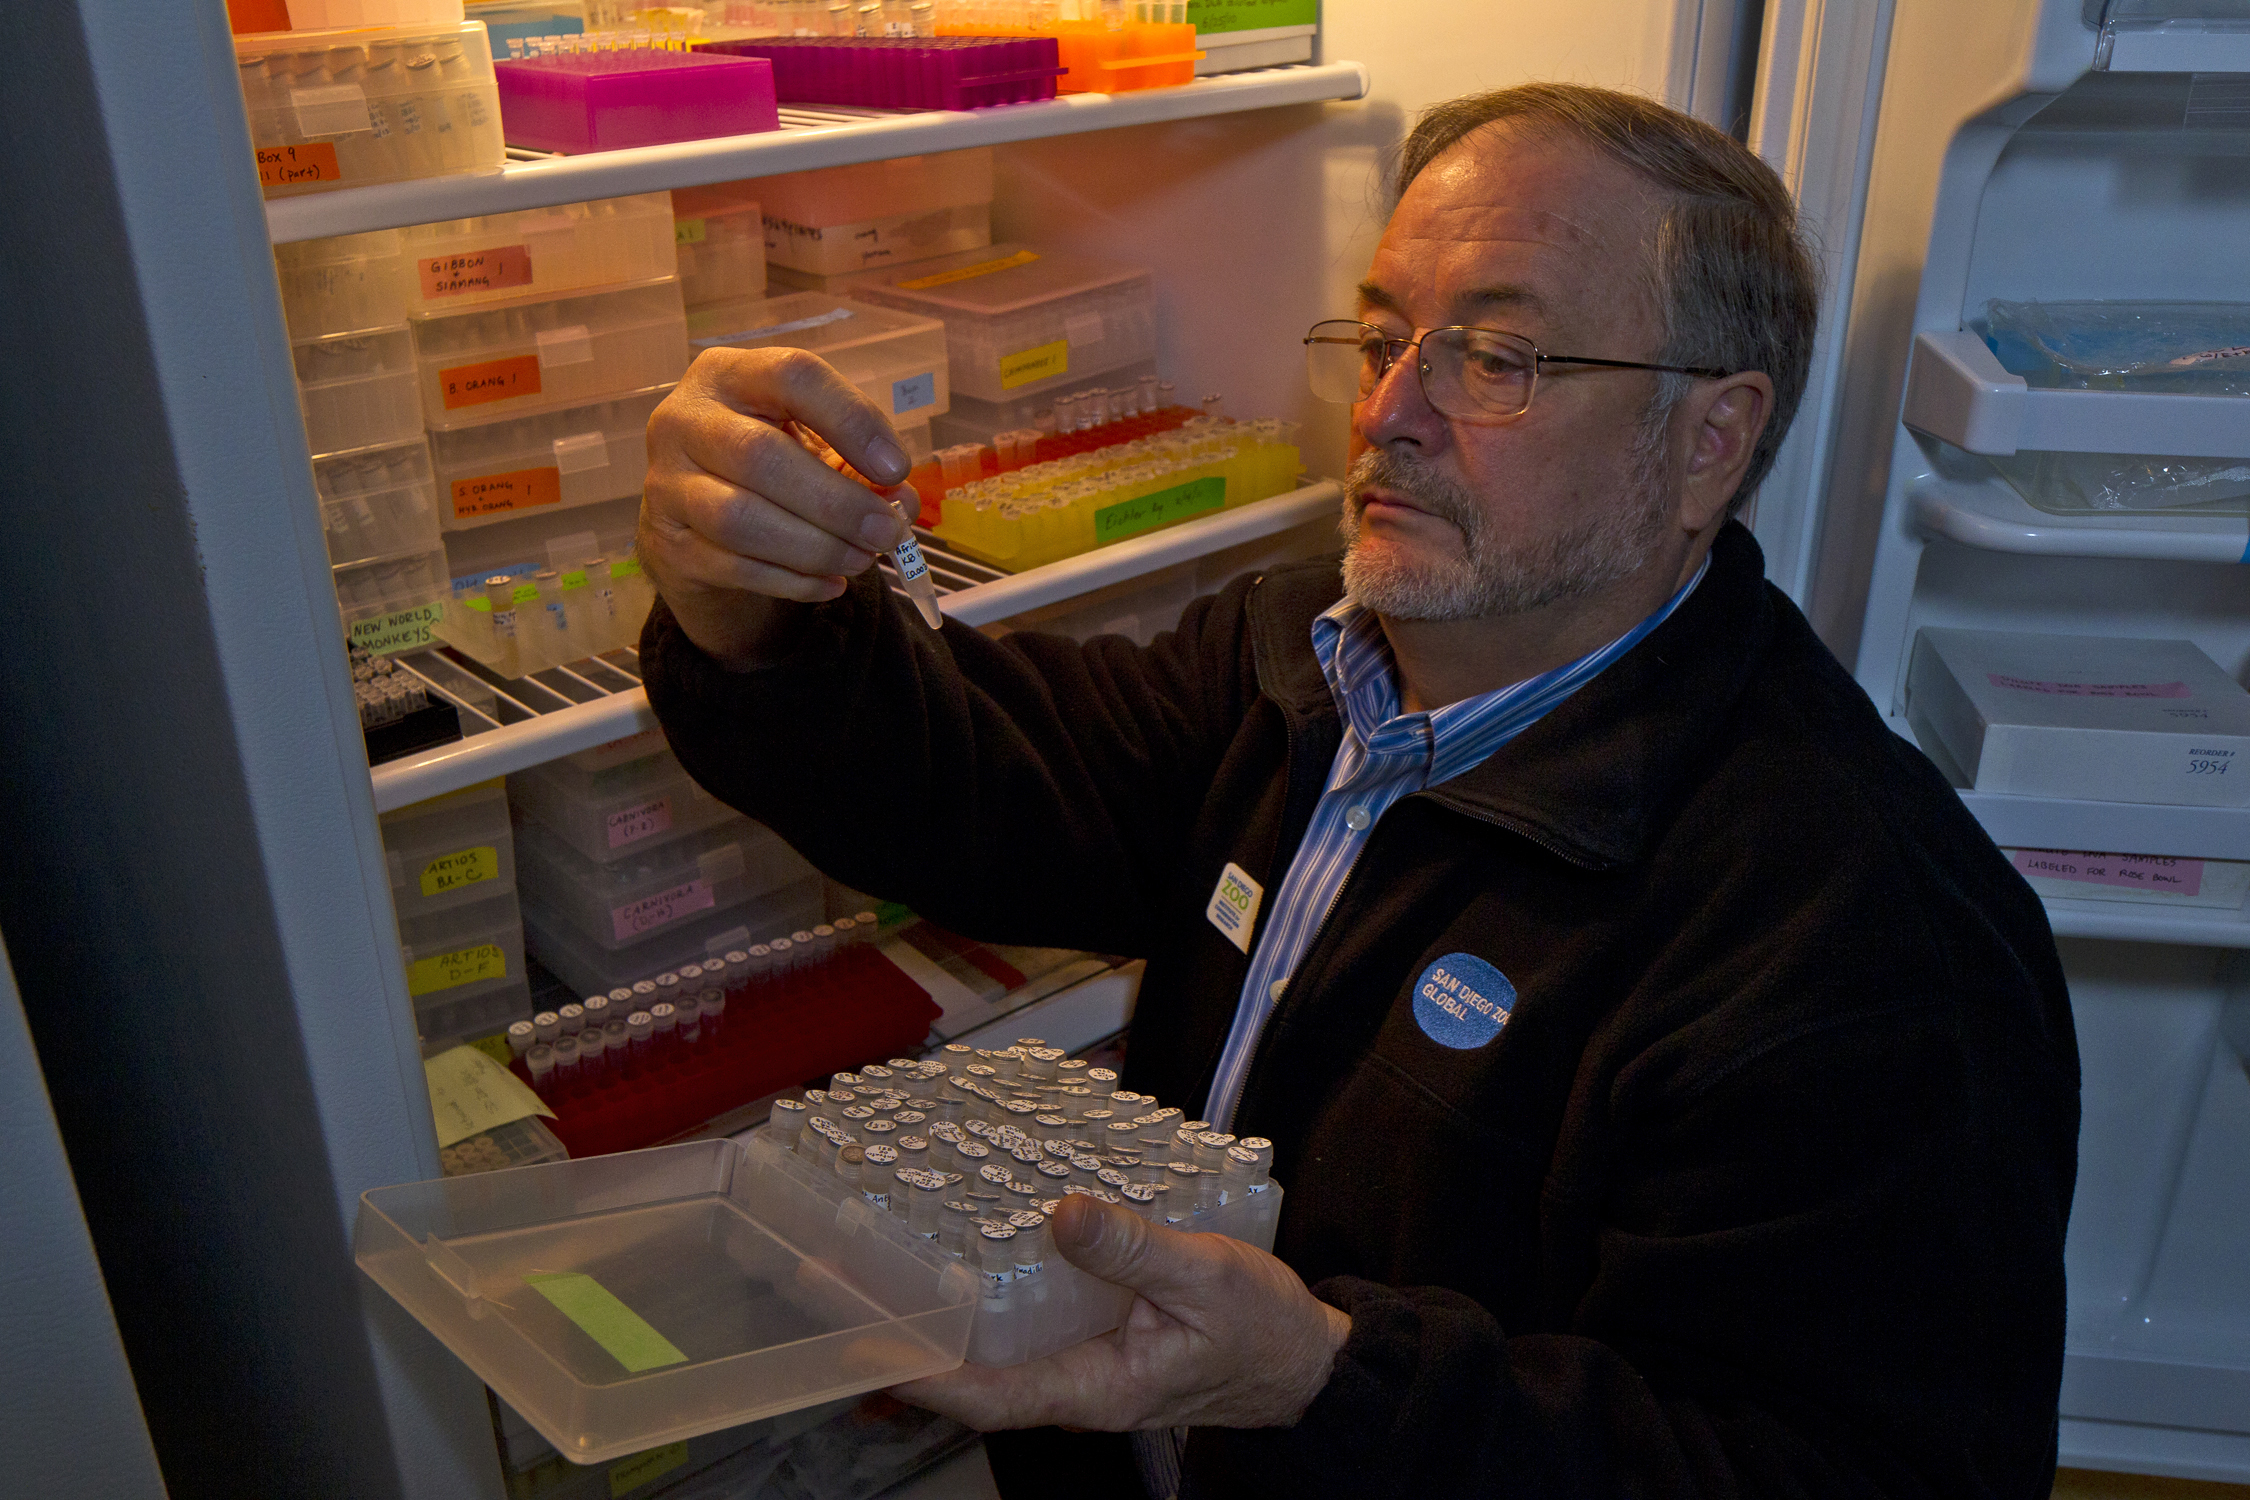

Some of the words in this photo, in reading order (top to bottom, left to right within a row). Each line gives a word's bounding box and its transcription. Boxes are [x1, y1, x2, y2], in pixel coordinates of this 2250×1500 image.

[257, 151, 281, 163] Box
[287, 147, 296, 161] 9
[279, 164, 320, 182] (part)
[431, 257, 484, 273] GIBBON
[435, 276, 489, 292] SIAMANG
[466, 375, 504, 391] ORANG
[472, 481, 513, 494] ORANG
[354, 620, 381, 637] NEW
[388, 608, 432, 627] WORLD
[363, 625, 430, 650] MONKEYS
[2188, 748, 2229, 757] REORDER
[2186, 759, 2230, 775] 5954
[609, 801, 664, 827] CARNIVORA
[428, 852, 478, 875] ARTIOS
[2028, 859, 2077, 874] LABELED
[2087, 867, 2106, 876] FOR
[2119, 869, 2145, 880] ROSE
[2152, 873, 2182, 884] BOWL
[623, 885, 694, 920] CARNIVORA
[1222, 879, 1249, 910] ZOO
[440, 947, 499, 968] ARTIOS
[1422, 983, 1467, 1020] GLOBAL
[1432, 968, 1460, 993] SAN
[1458, 984, 1493, 1015] DIEGO
